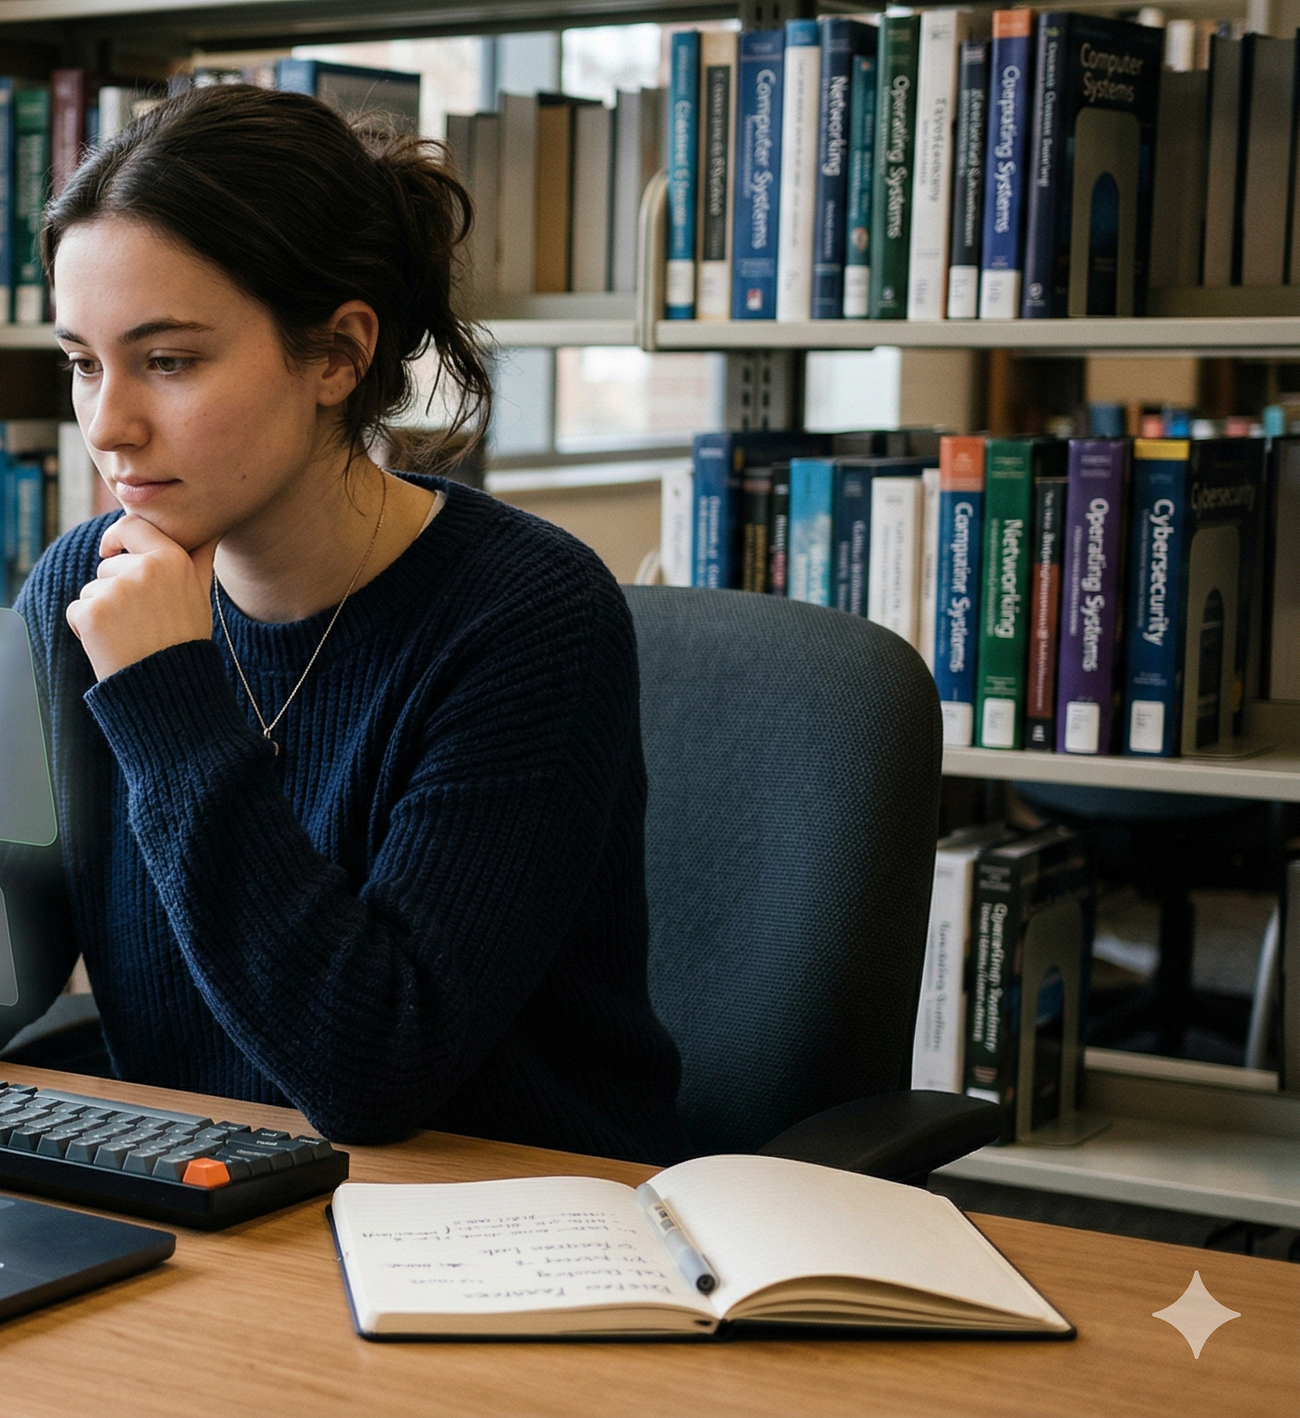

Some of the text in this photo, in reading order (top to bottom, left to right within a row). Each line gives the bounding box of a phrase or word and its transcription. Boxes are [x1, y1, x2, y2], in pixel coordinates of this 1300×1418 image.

[1081, 42, 1144, 77] Computer
[1083, 71, 1135, 103] Systems
[822, 75, 848, 177] Networking
[886, 75, 910, 163] Operating
[1143, 498, 1175, 646] Cybersecurity
